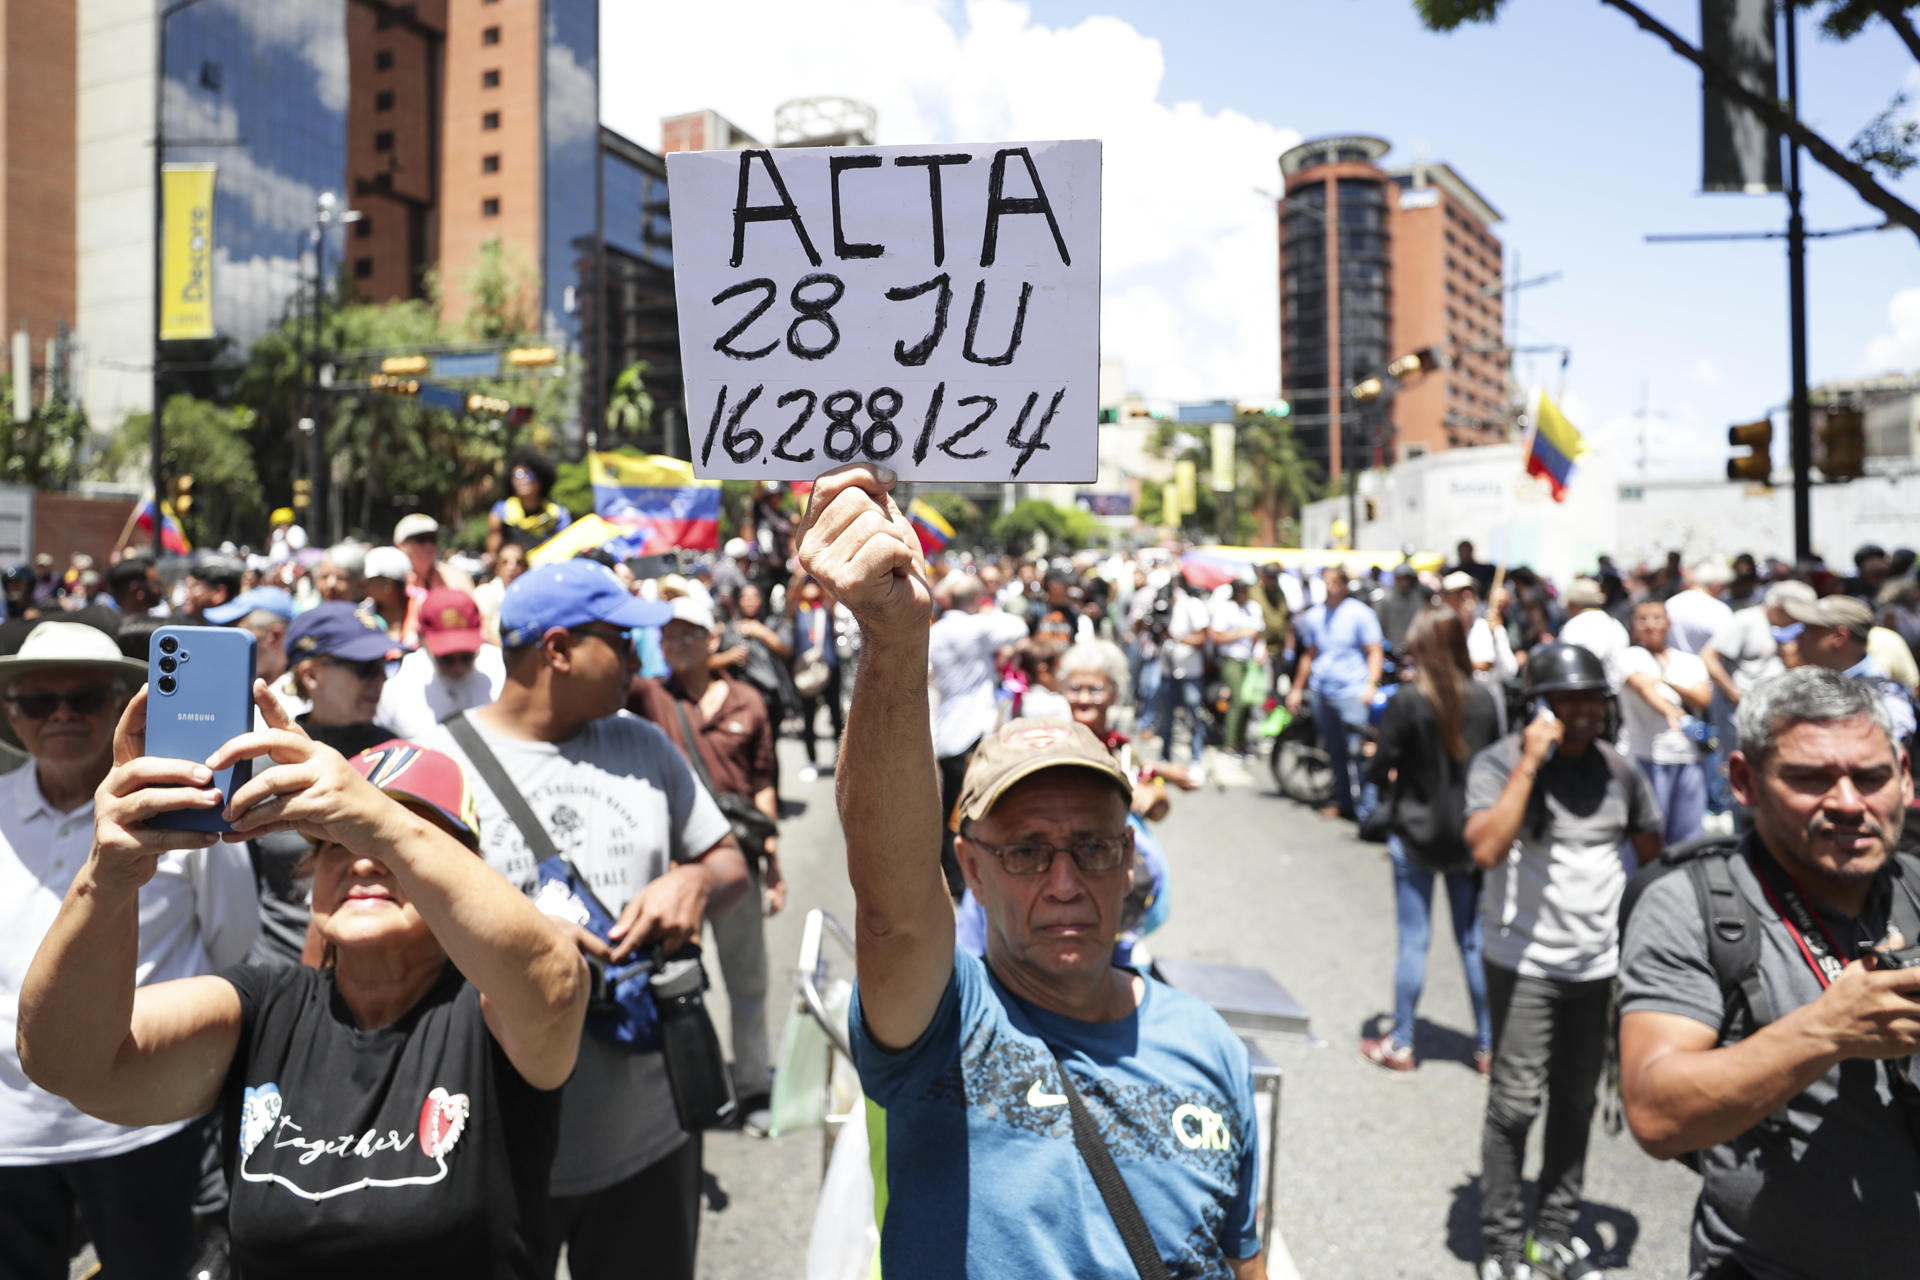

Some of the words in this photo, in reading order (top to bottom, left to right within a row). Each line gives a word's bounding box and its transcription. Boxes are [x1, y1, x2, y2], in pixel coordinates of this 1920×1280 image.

[729, 147, 1071, 267] ACTA
[712, 273, 845, 360] 28
[884, 272, 1033, 366] JU
[177, 712, 215, 722] SAMSUNG
